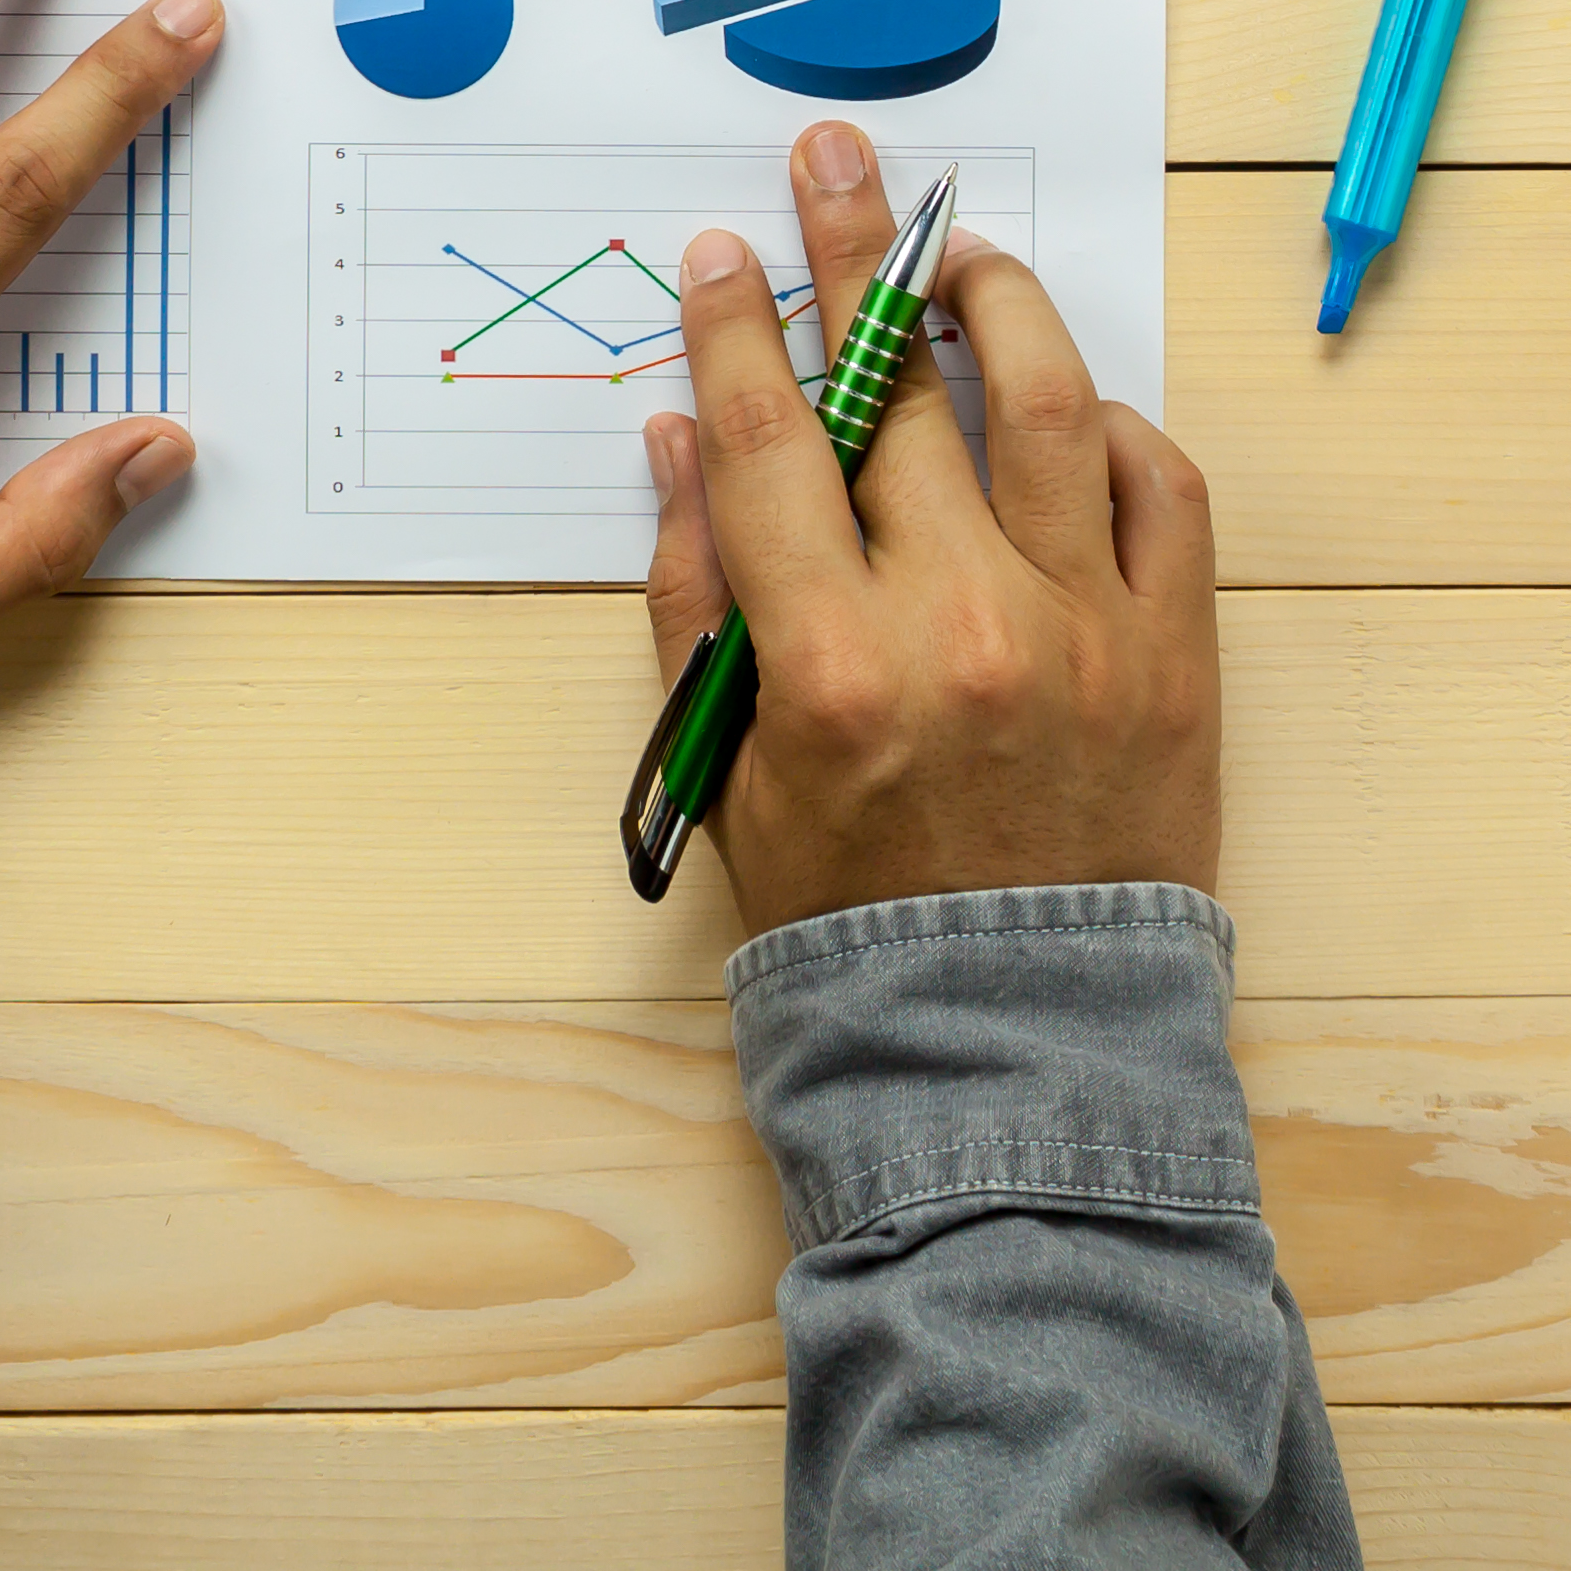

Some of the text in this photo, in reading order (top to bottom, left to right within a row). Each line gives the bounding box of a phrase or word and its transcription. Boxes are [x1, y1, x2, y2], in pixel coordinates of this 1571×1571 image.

[335, 147, 346, 160] 6
[335, 202, 345, 215] 5
[334, 258, 345, 270] 4
[334, 314, 345, 327] 3
[334, 370, 344, 383] 2
[334, 426, 343, 438] 1
[332, 481, 344, 494] 0
